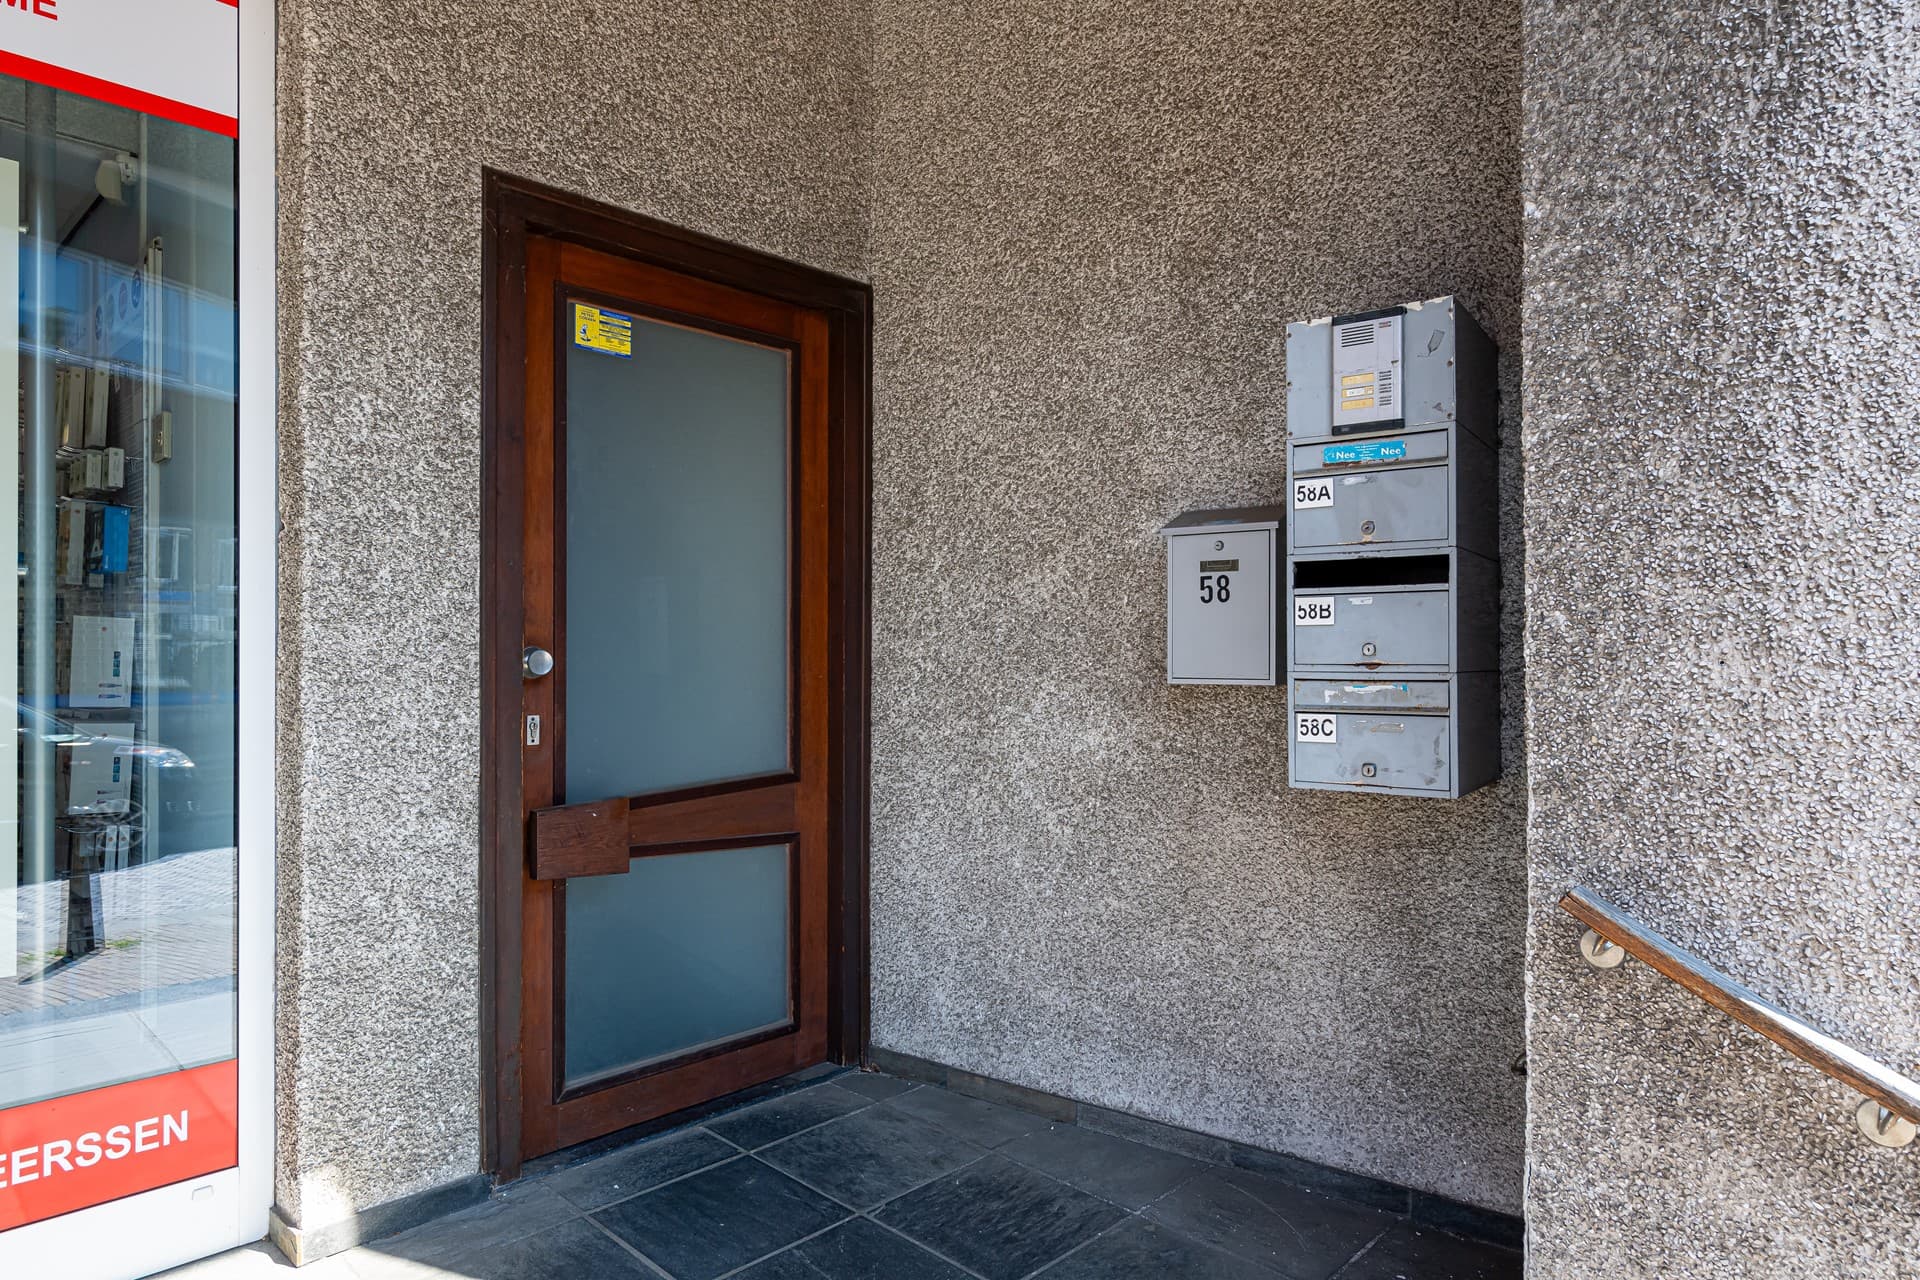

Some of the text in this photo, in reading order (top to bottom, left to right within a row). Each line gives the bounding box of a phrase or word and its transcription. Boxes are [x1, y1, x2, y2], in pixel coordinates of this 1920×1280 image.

[1335, 451, 1356, 459] Nee
[1380, 447, 1401, 456] Nee
[1296, 485, 1331, 502] 58A
[1200, 575, 1231, 604] 58
[1297, 603, 1332, 620] 58B
[1300, 718, 1334, 736] 58C
